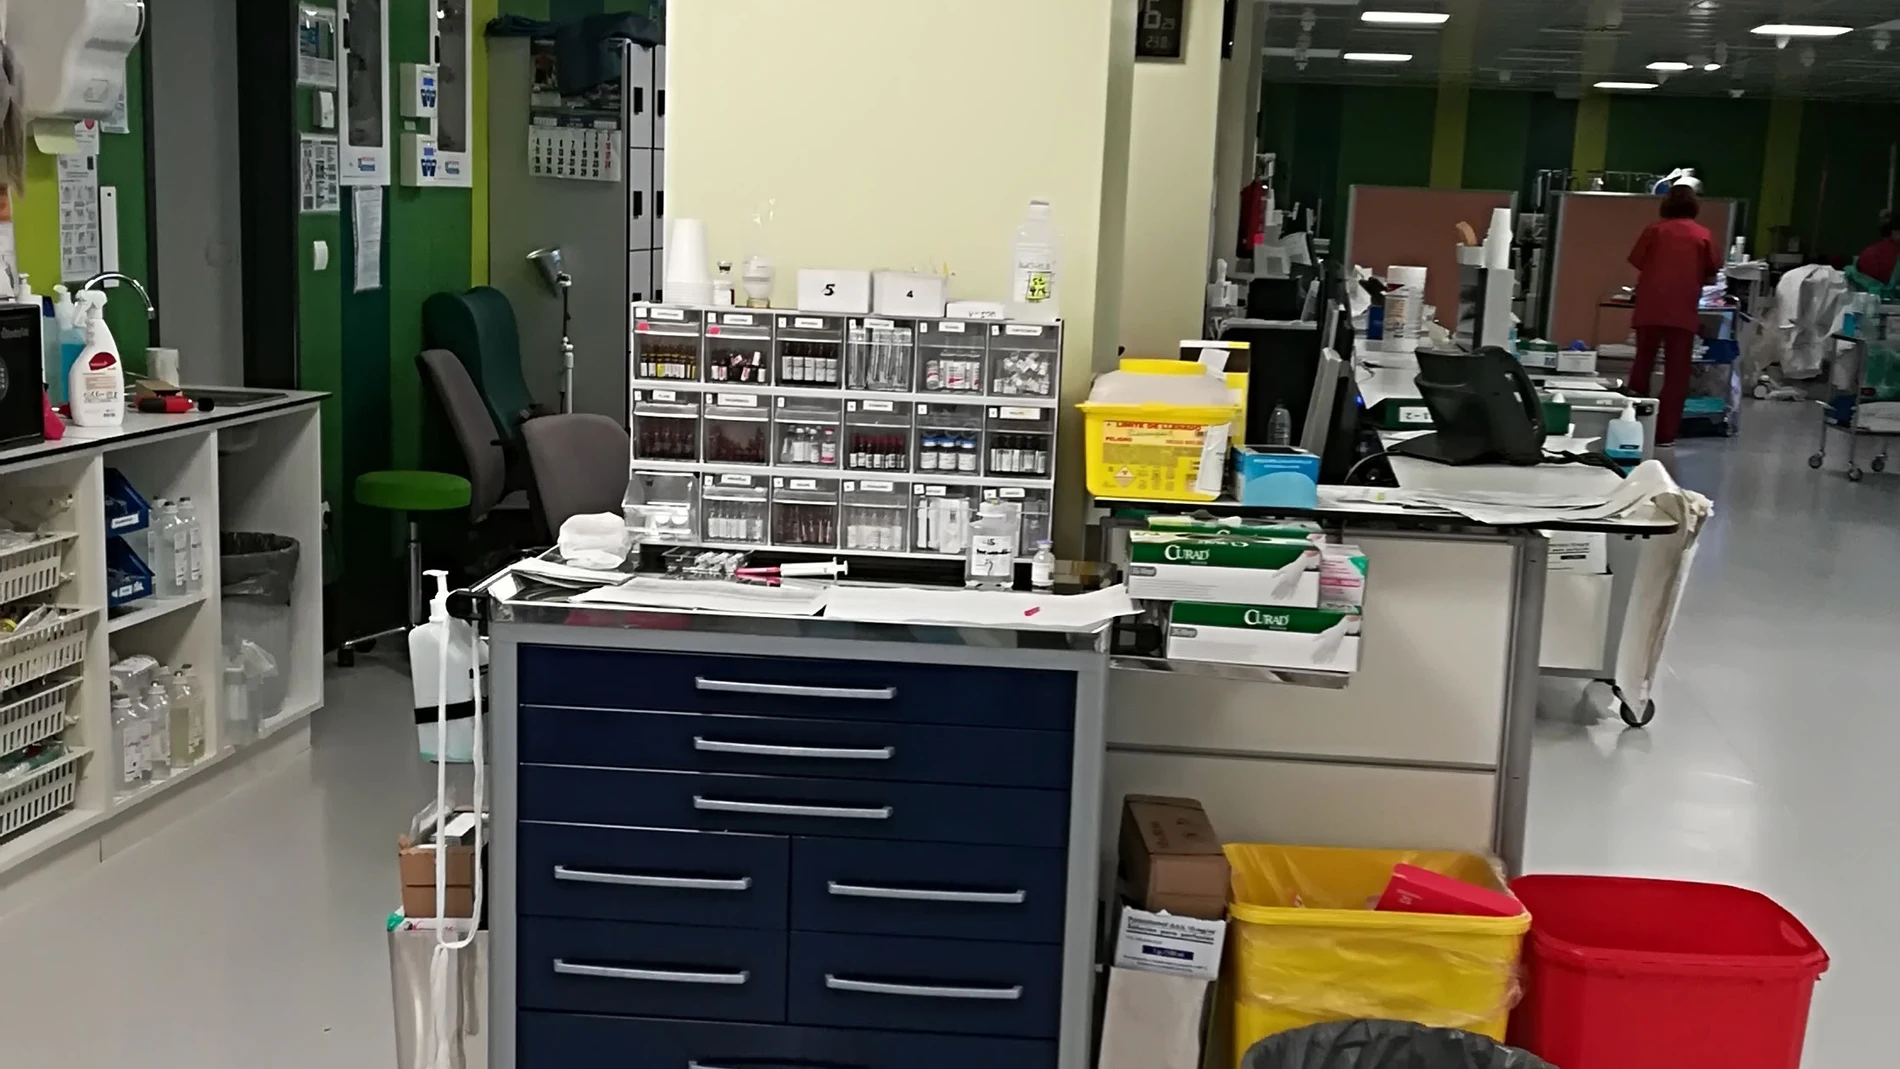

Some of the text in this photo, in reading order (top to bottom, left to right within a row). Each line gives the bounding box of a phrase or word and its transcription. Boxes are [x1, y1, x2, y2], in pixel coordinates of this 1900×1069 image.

[824, 284, 835, 296] 5
[906, 290, 914, 298] 4
[1164, 544, 1210, 560] CURAD
[1244, 609, 1289, 626] CURAD
